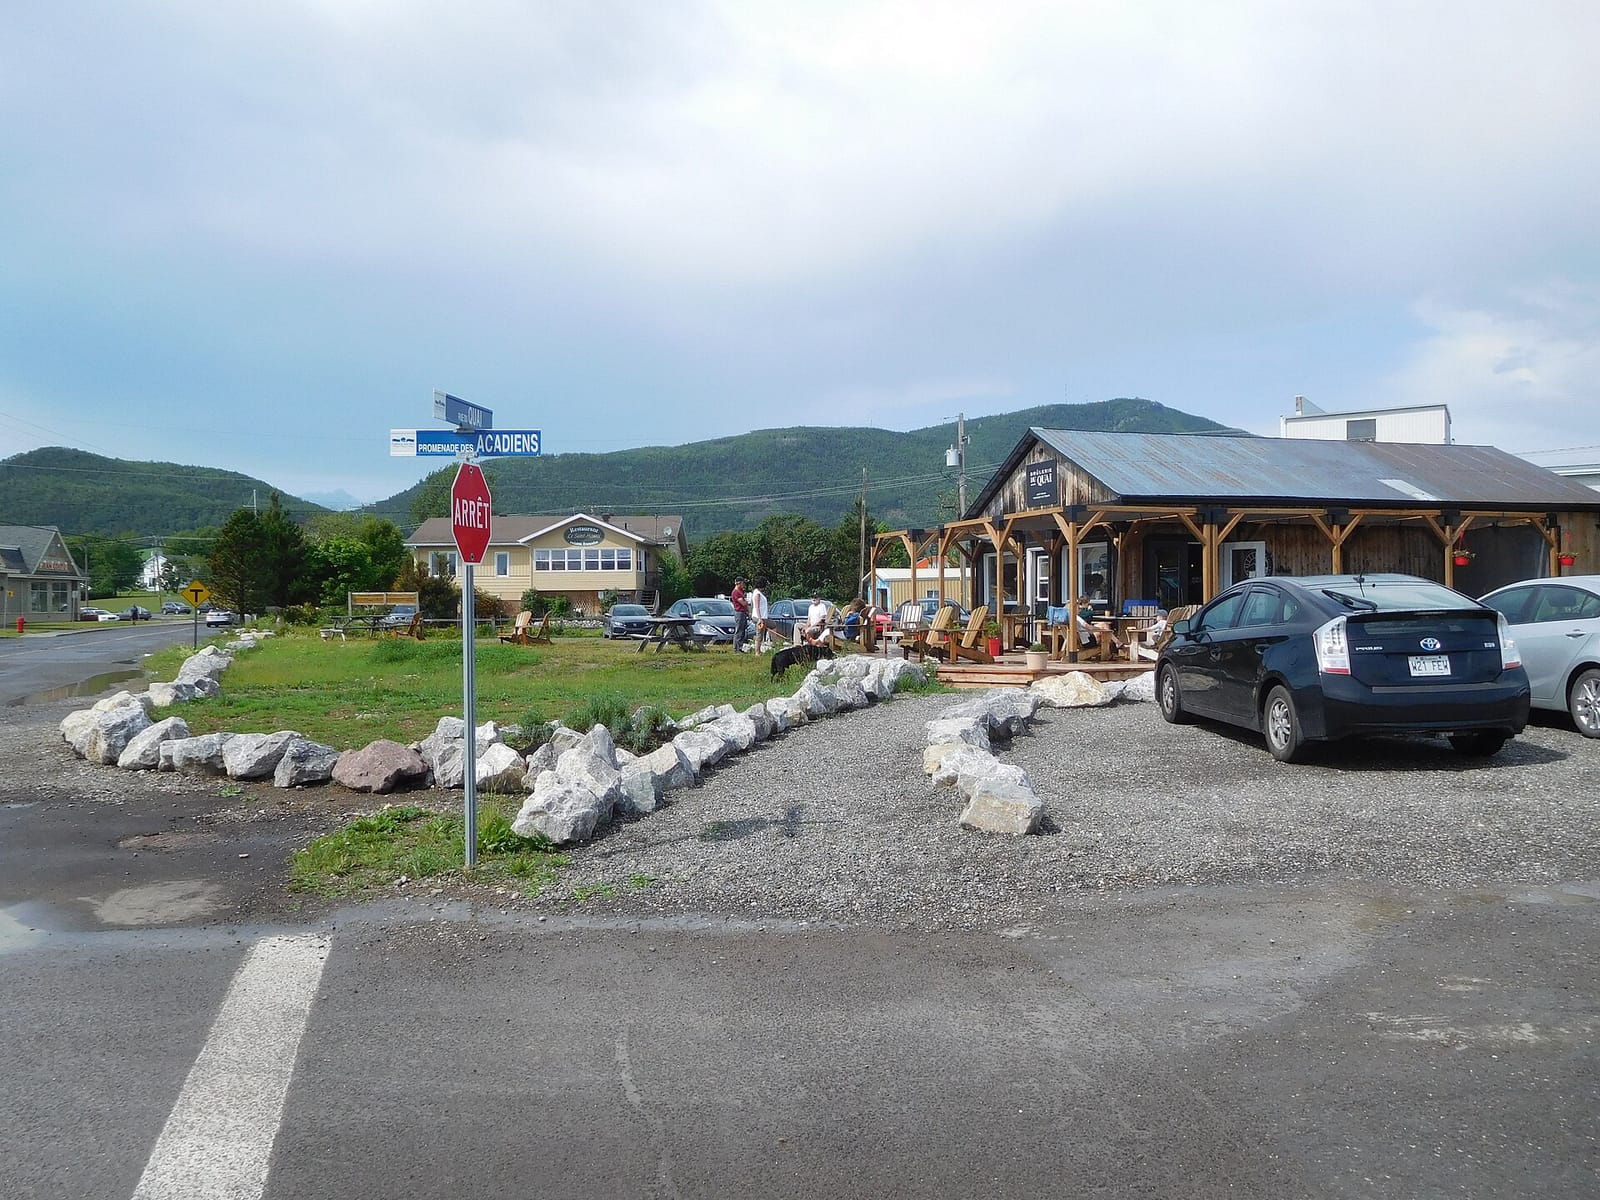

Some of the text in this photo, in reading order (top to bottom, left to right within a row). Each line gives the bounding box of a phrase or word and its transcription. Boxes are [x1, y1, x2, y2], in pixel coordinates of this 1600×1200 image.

[467, 406, 482, 427] QUAI
[418, 433, 539, 453] PROMENADE DES ACADIENS
[1036, 473, 1052, 486] QUAI
[454, 496, 489, 529] ARRÊT
